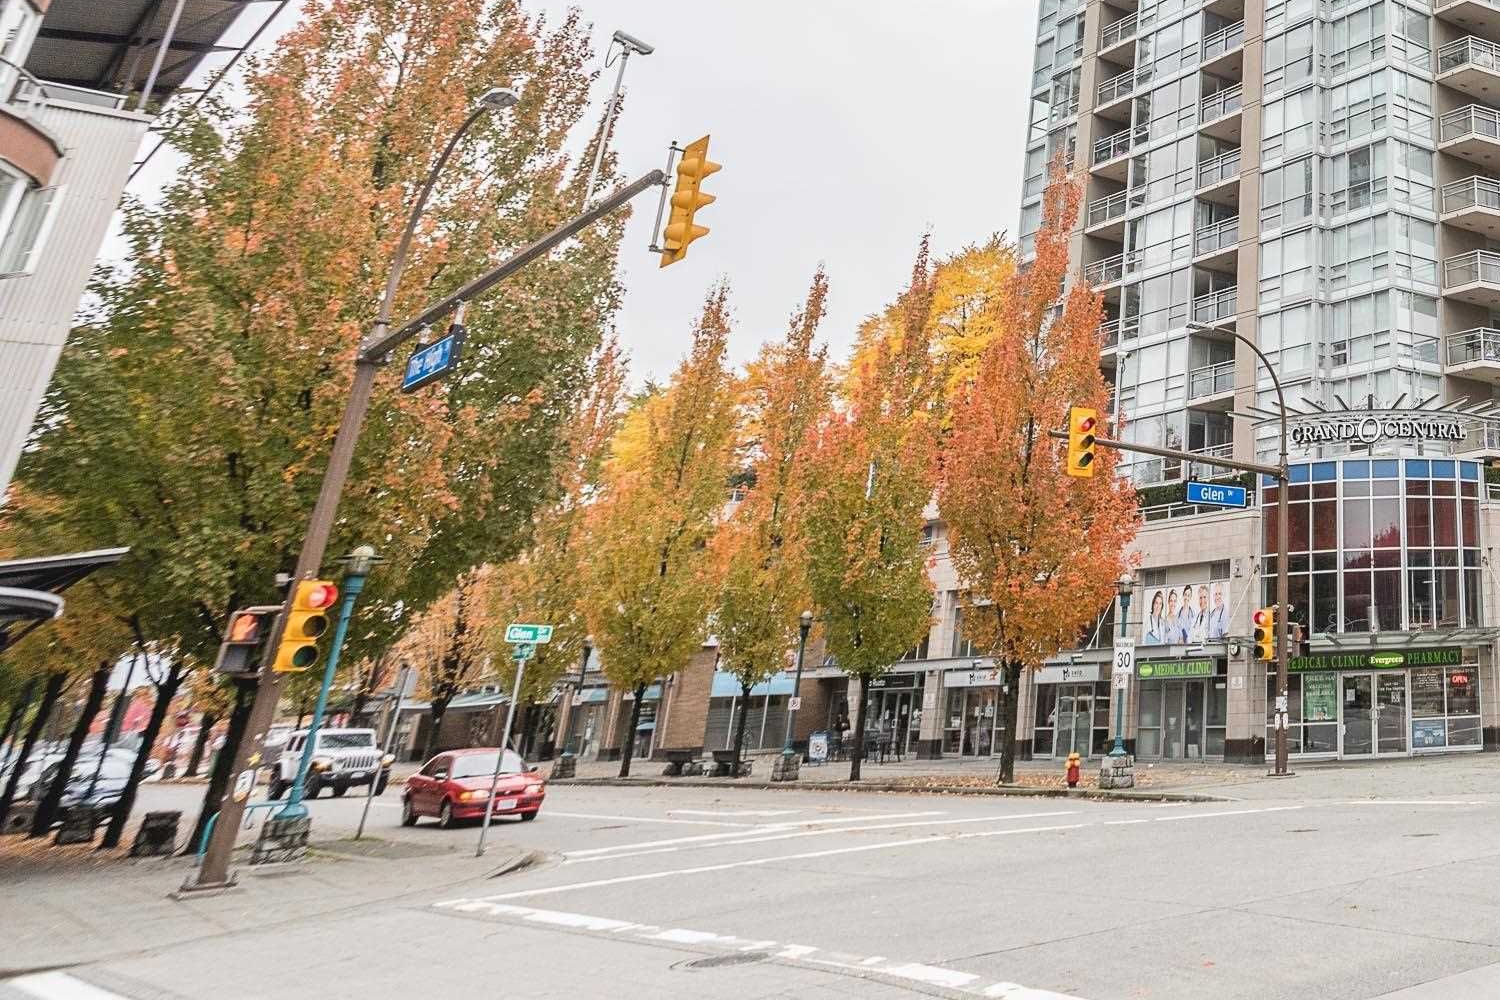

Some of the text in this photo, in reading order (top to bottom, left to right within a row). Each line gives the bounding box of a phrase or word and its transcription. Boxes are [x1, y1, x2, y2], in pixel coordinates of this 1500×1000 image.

[1291, 423, 1357, 443] GRAND
[1384, 420, 1468, 440] CENTRAL
[1200, 487, 1225, 502] Glen
[1117, 652, 1131, 668] 30
[1331, 655, 1366, 668] CLINIC
[1370, 656, 1404, 665] Evergreen
[1407, 651, 1459, 665] PHARMACY
[1154, 663, 1184, 675] MEDICAL
[1187, 661, 1212, 674] CLINIC
